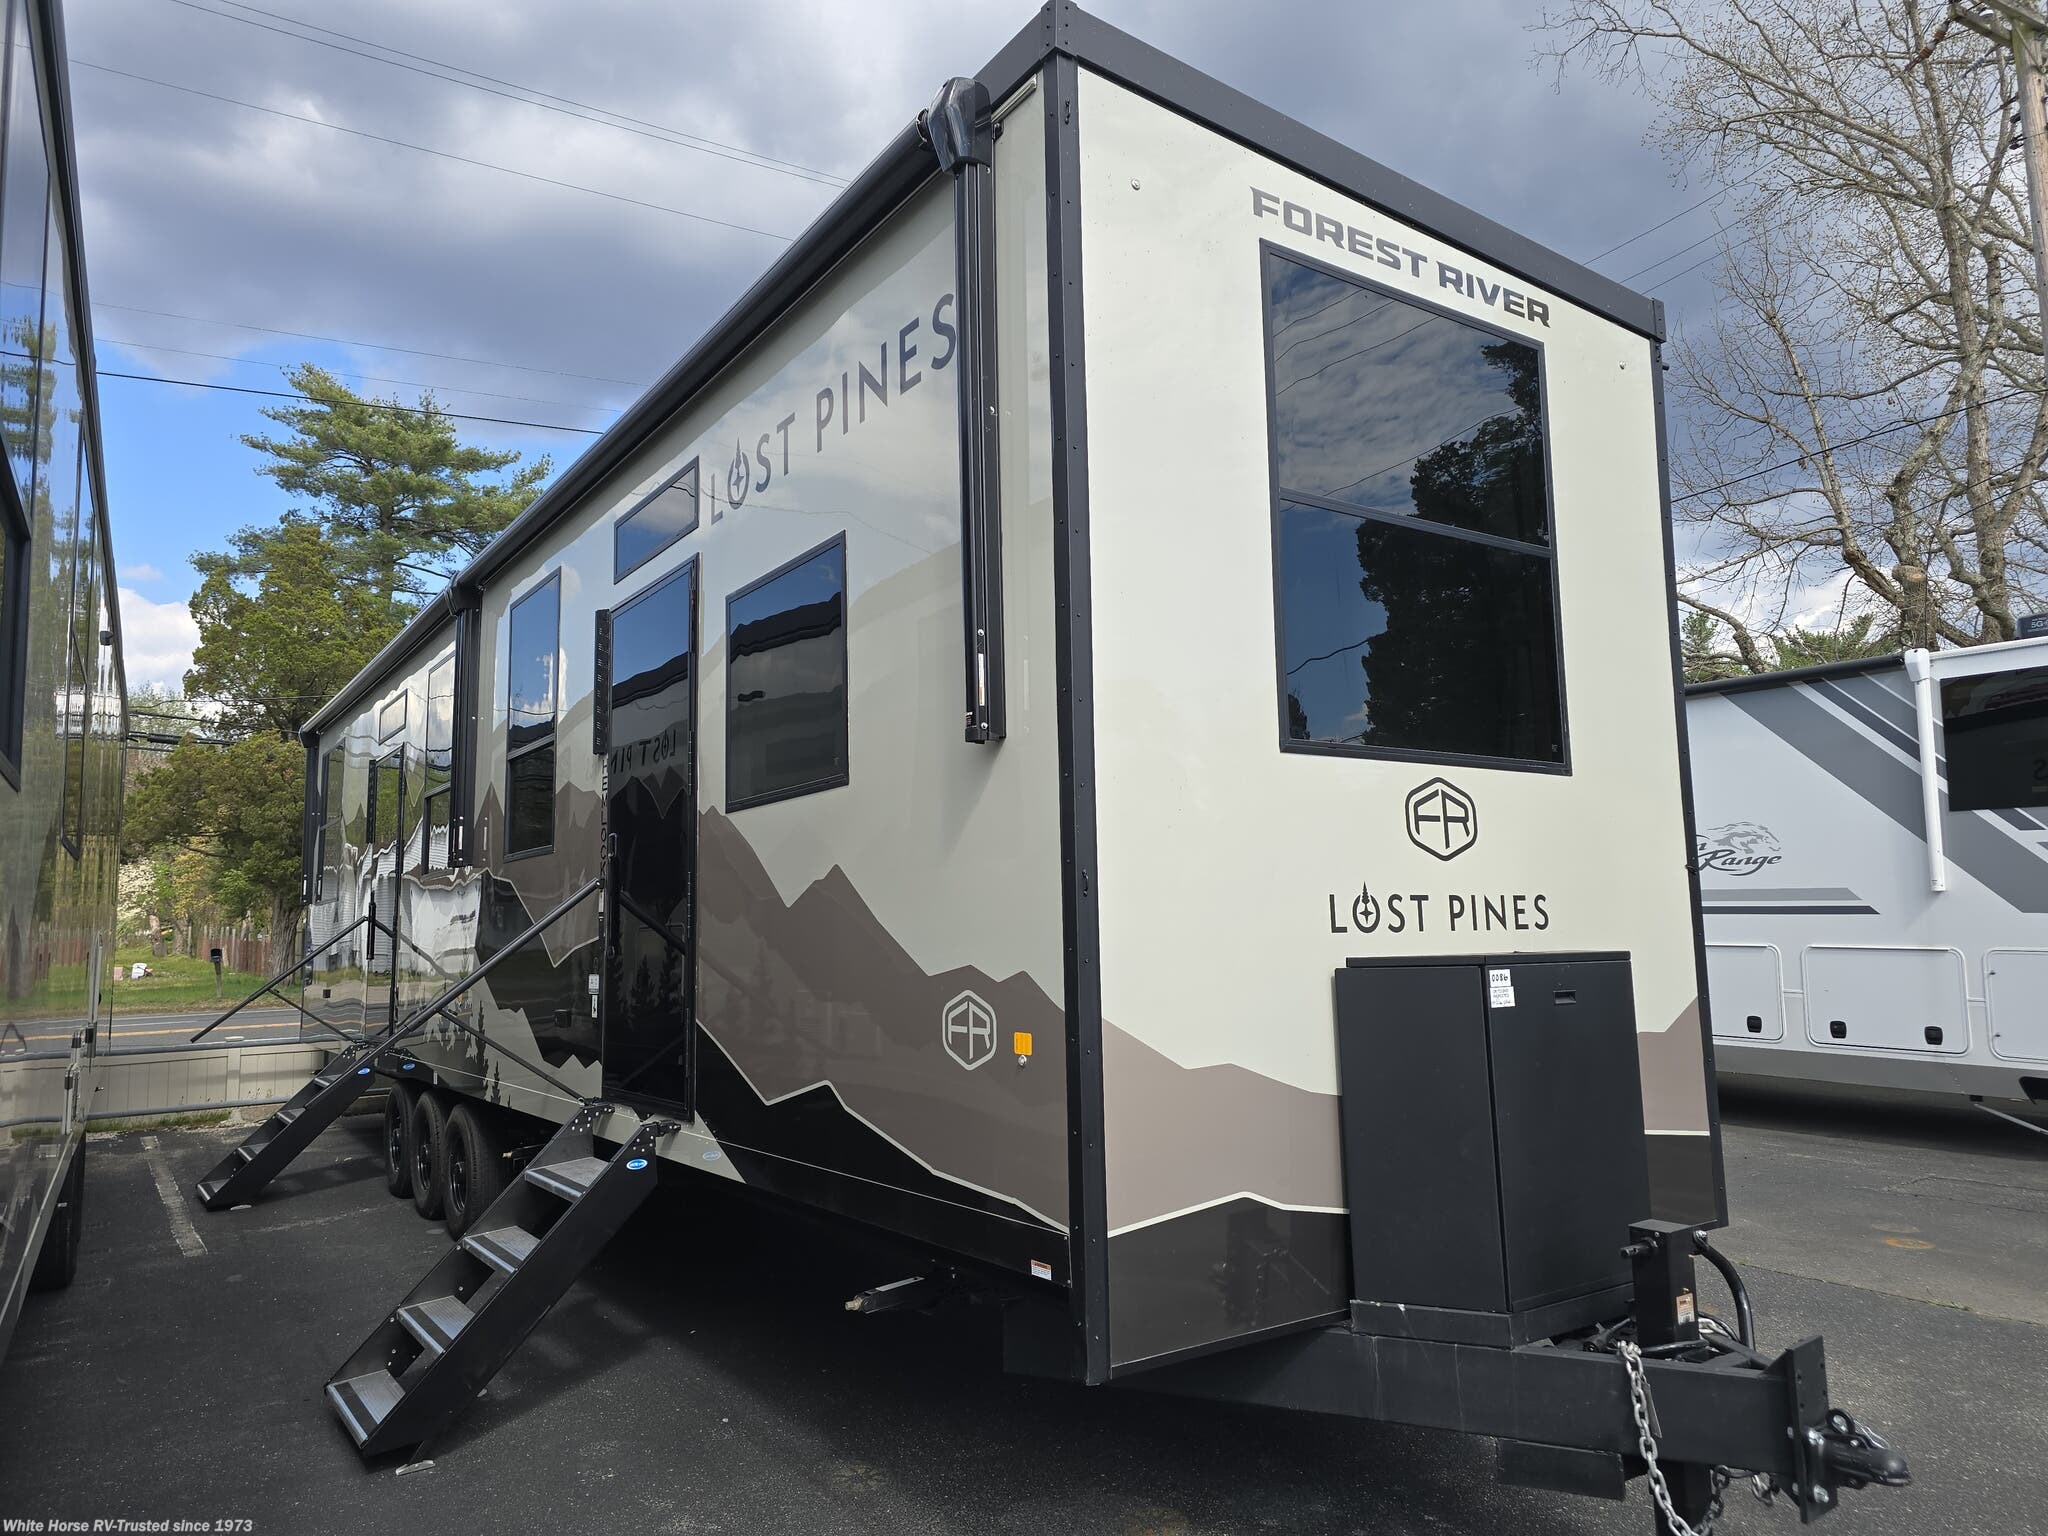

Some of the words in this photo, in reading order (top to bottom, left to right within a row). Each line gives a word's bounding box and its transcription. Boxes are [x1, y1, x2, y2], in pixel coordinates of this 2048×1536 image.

[1250, 186, 1428, 278] FOREST
[1437, 260, 1551, 329] RIVER
[710, 411, 796, 527] LOST
[815, 292, 957, 454] PINES
[1329, 881, 1429, 934] LOST
[1448, 893, 1550, 931] PINES
[1697, 849, 1782, 876] Range
